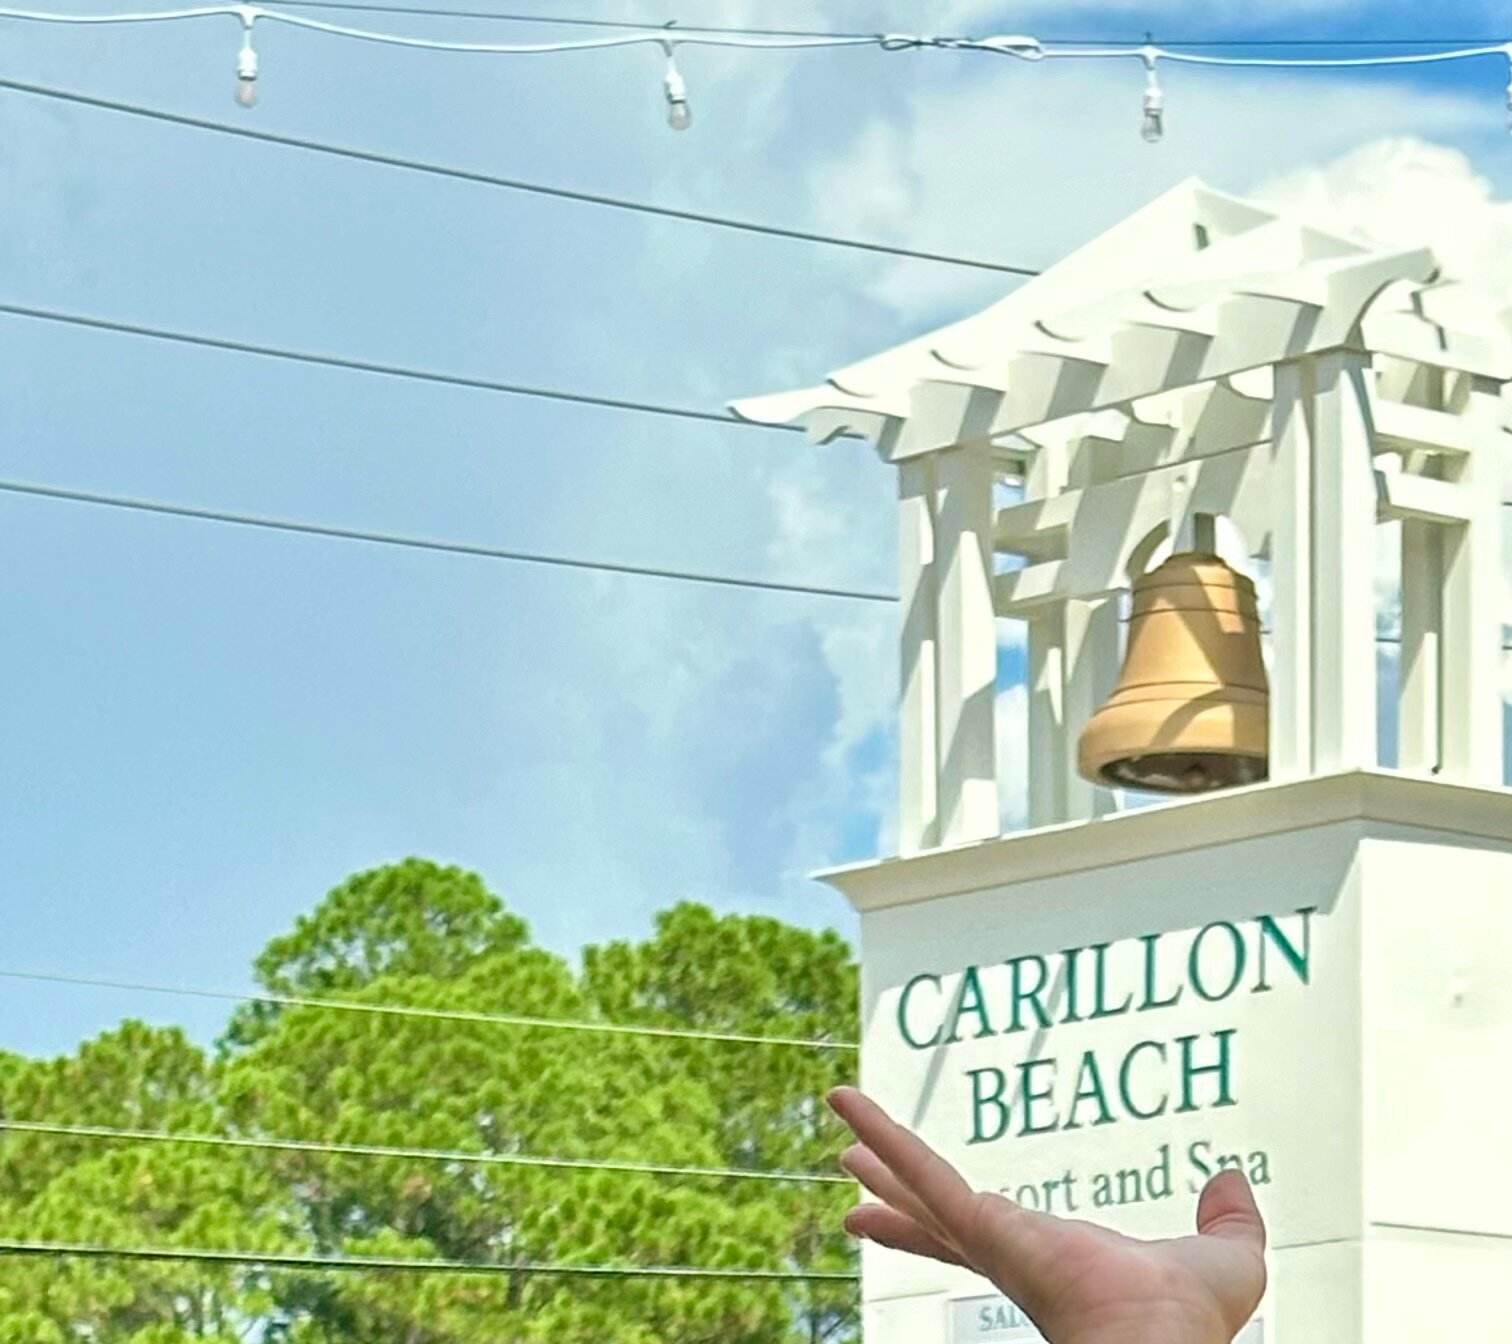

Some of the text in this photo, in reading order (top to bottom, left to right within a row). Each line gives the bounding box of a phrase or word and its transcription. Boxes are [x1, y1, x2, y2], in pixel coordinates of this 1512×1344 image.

[896, 906, 1317, 1051] CARILLON
[964, 1028, 1238, 1146] BEACH
[1092, 1143, 1174, 1209] and
